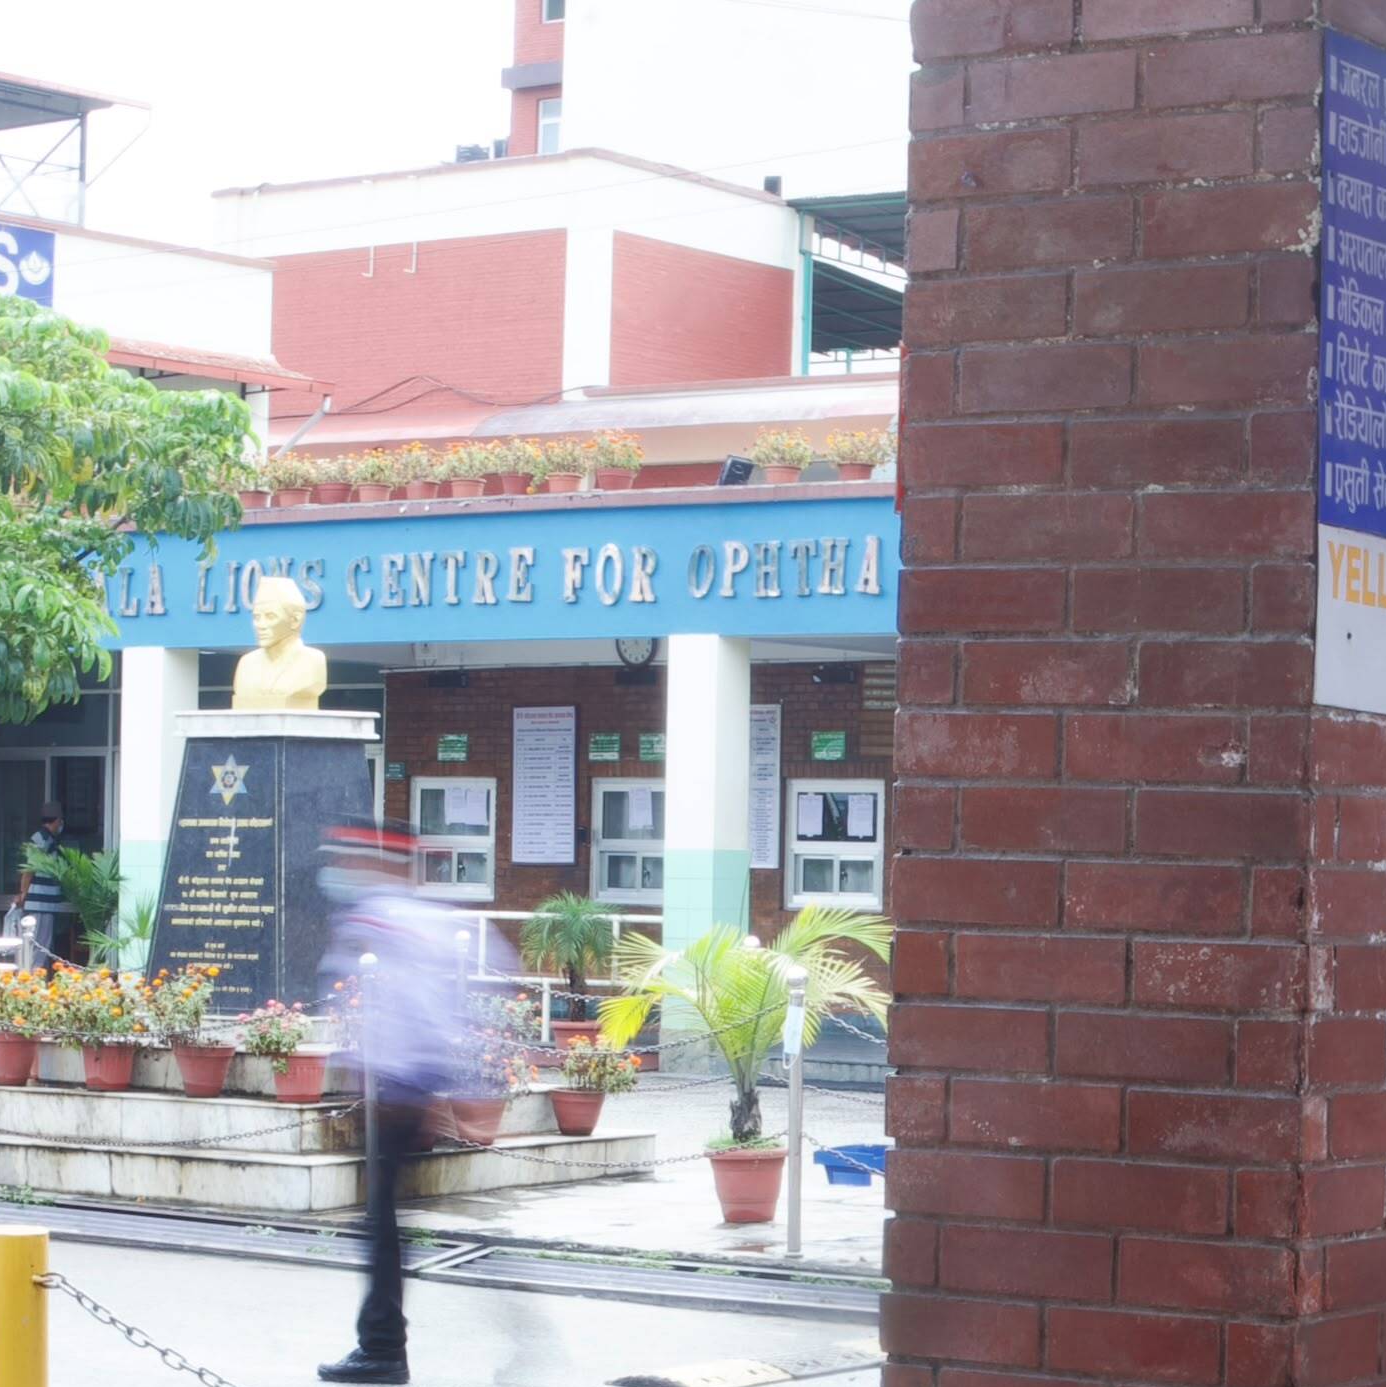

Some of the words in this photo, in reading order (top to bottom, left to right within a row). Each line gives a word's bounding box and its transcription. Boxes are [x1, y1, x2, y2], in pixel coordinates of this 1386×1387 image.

[346, 546, 536, 610] CENTRE
[563, 542, 659, 607] FOR
[687, 534, 882, 599] OPHTHA
